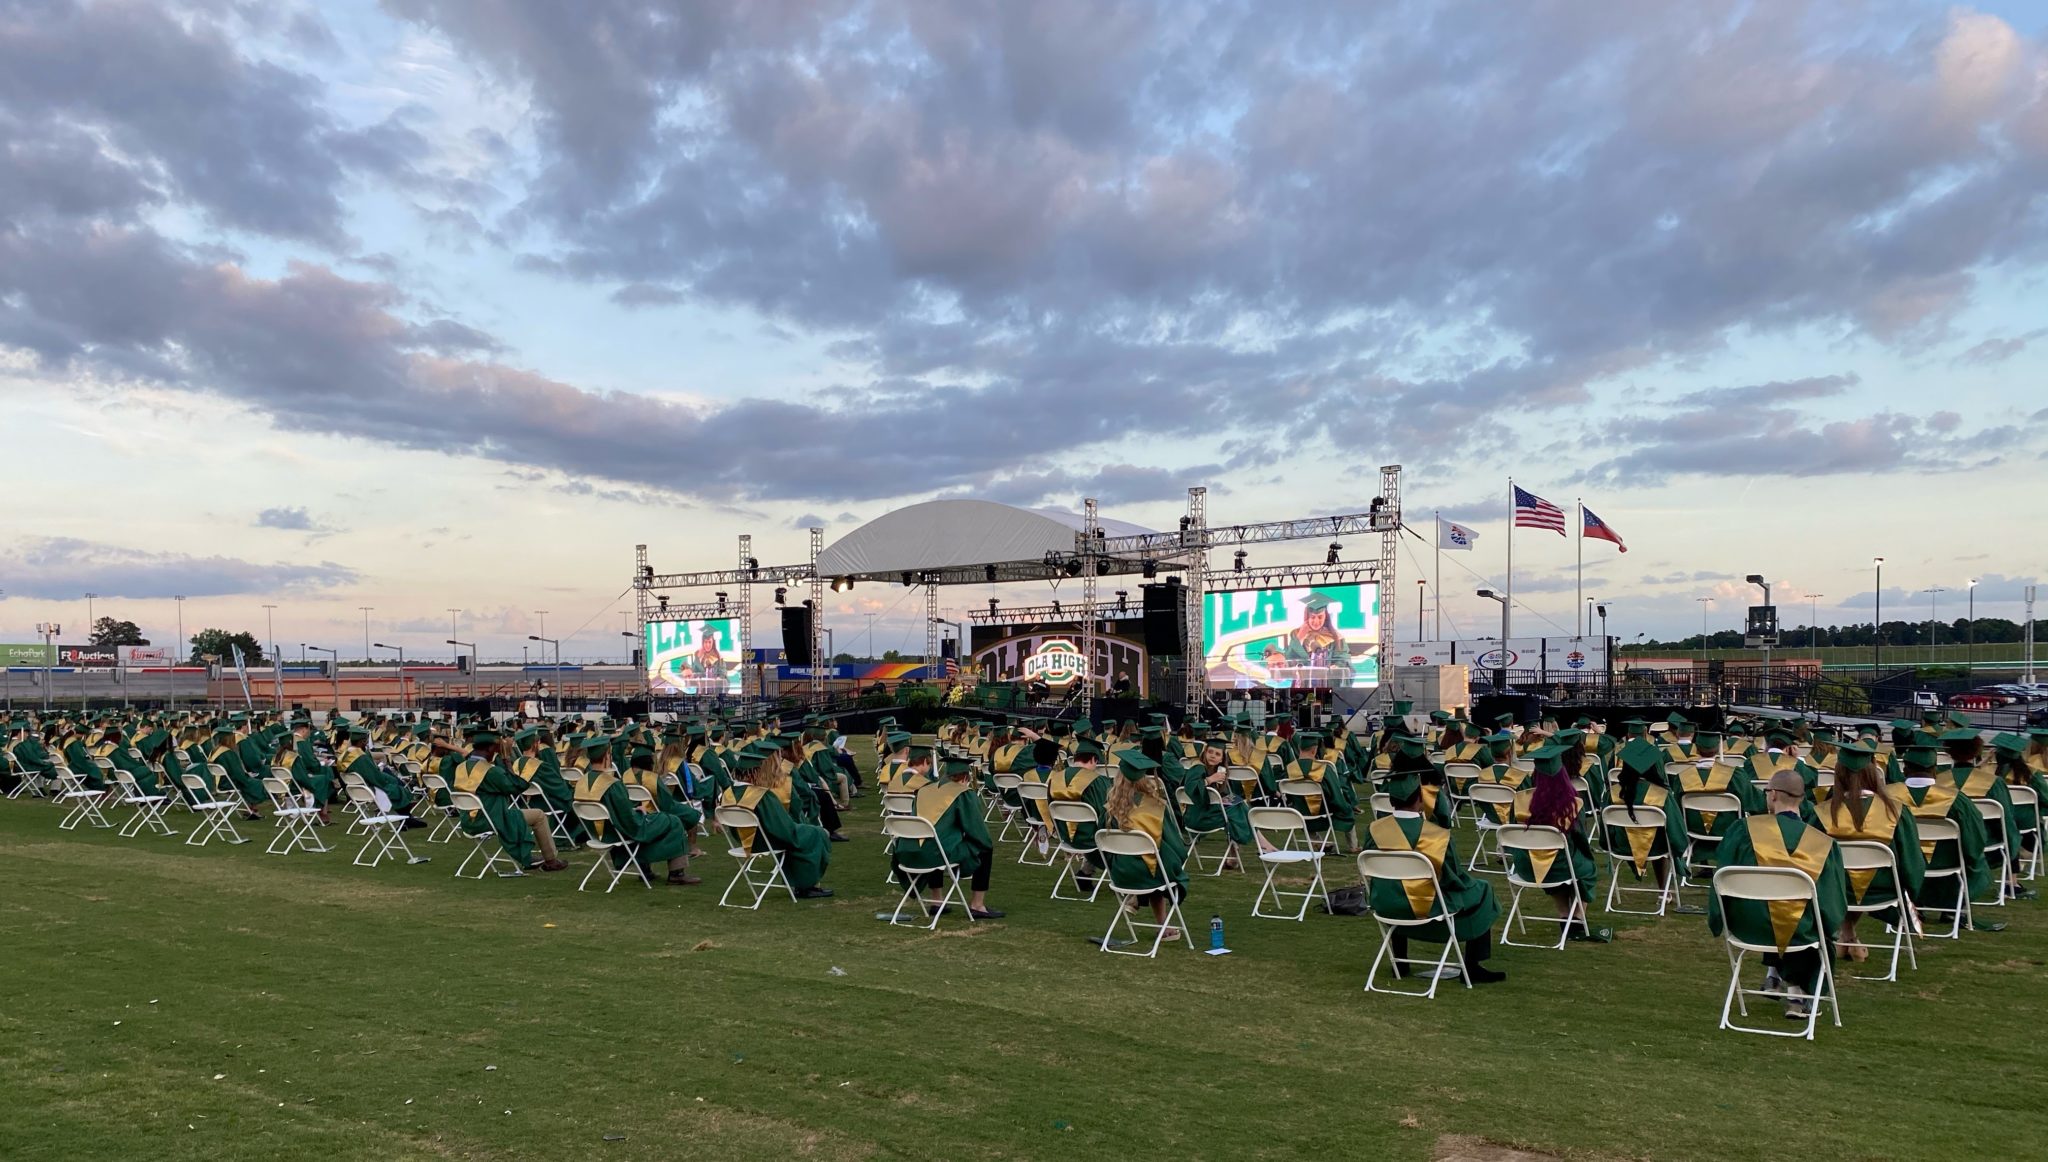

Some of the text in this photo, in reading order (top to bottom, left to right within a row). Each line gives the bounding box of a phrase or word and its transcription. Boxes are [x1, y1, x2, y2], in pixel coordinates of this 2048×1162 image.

[9, 648, 46, 658] EchoPark
[1028, 654, 1086, 675] OLA HIGH
